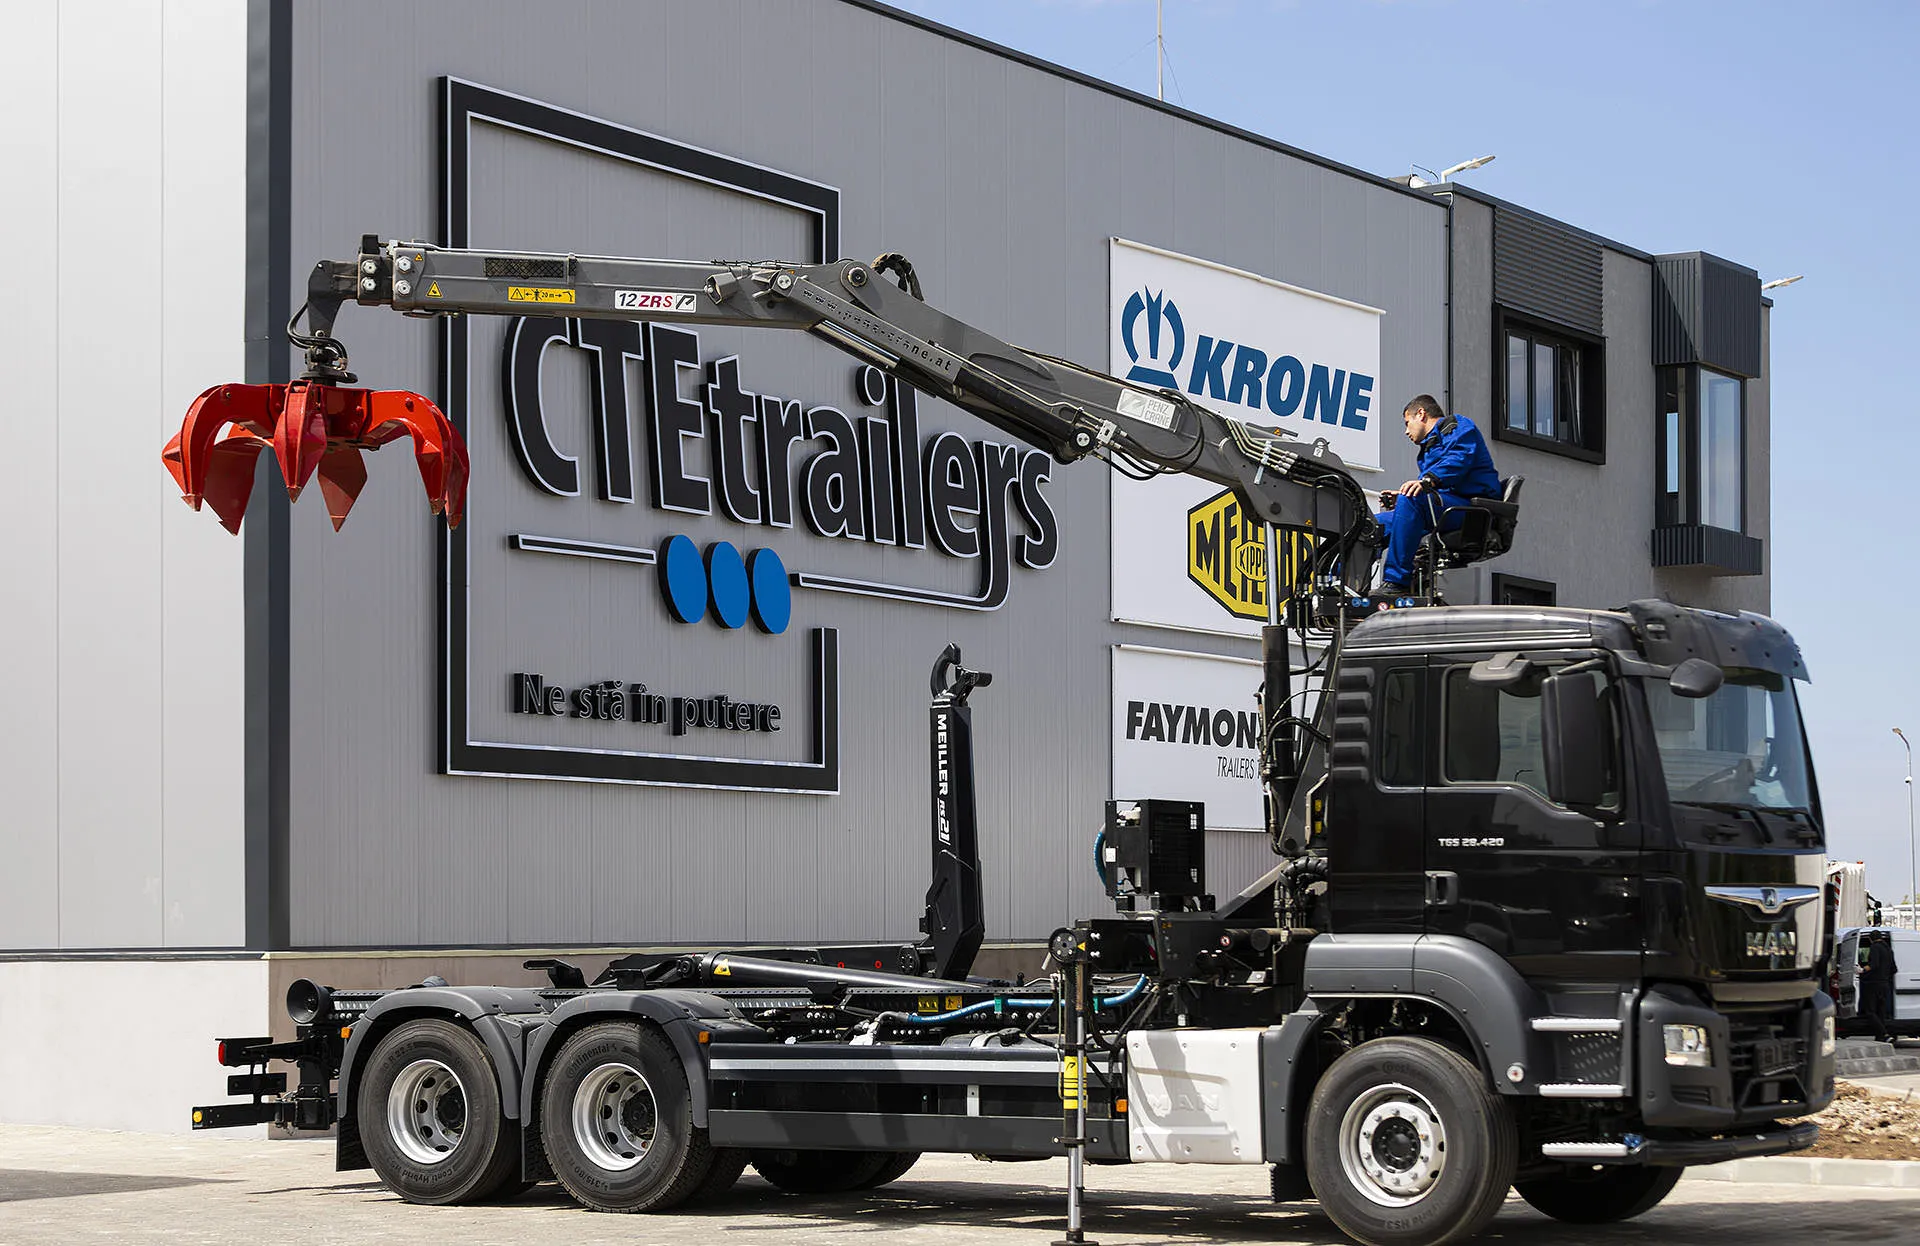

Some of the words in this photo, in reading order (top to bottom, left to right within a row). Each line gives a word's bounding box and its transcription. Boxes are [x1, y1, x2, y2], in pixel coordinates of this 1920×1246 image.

[1188, 334, 1374, 431] KRONE
[1144, 410, 1170, 427] CRANE
[1147, 399, 1169, 415] PENZ
[502, 314, 1060, 611] CTEtrailers
[1240, 546, 1267, 577] KIPP
[514, 672, 568, 717] Ne
[672, 694, 782, 736] putere
[1126, 700, 1263, 750] FAYMON
[937, 713, 949, 796] MEILLER
[1217, 756, 1255, 779] TRAILERS
[1437, 837, 1460, 848] TGS
[1461, 837, 1505, 848] 28.420
[1745, 931, 1796, 957] MAN
